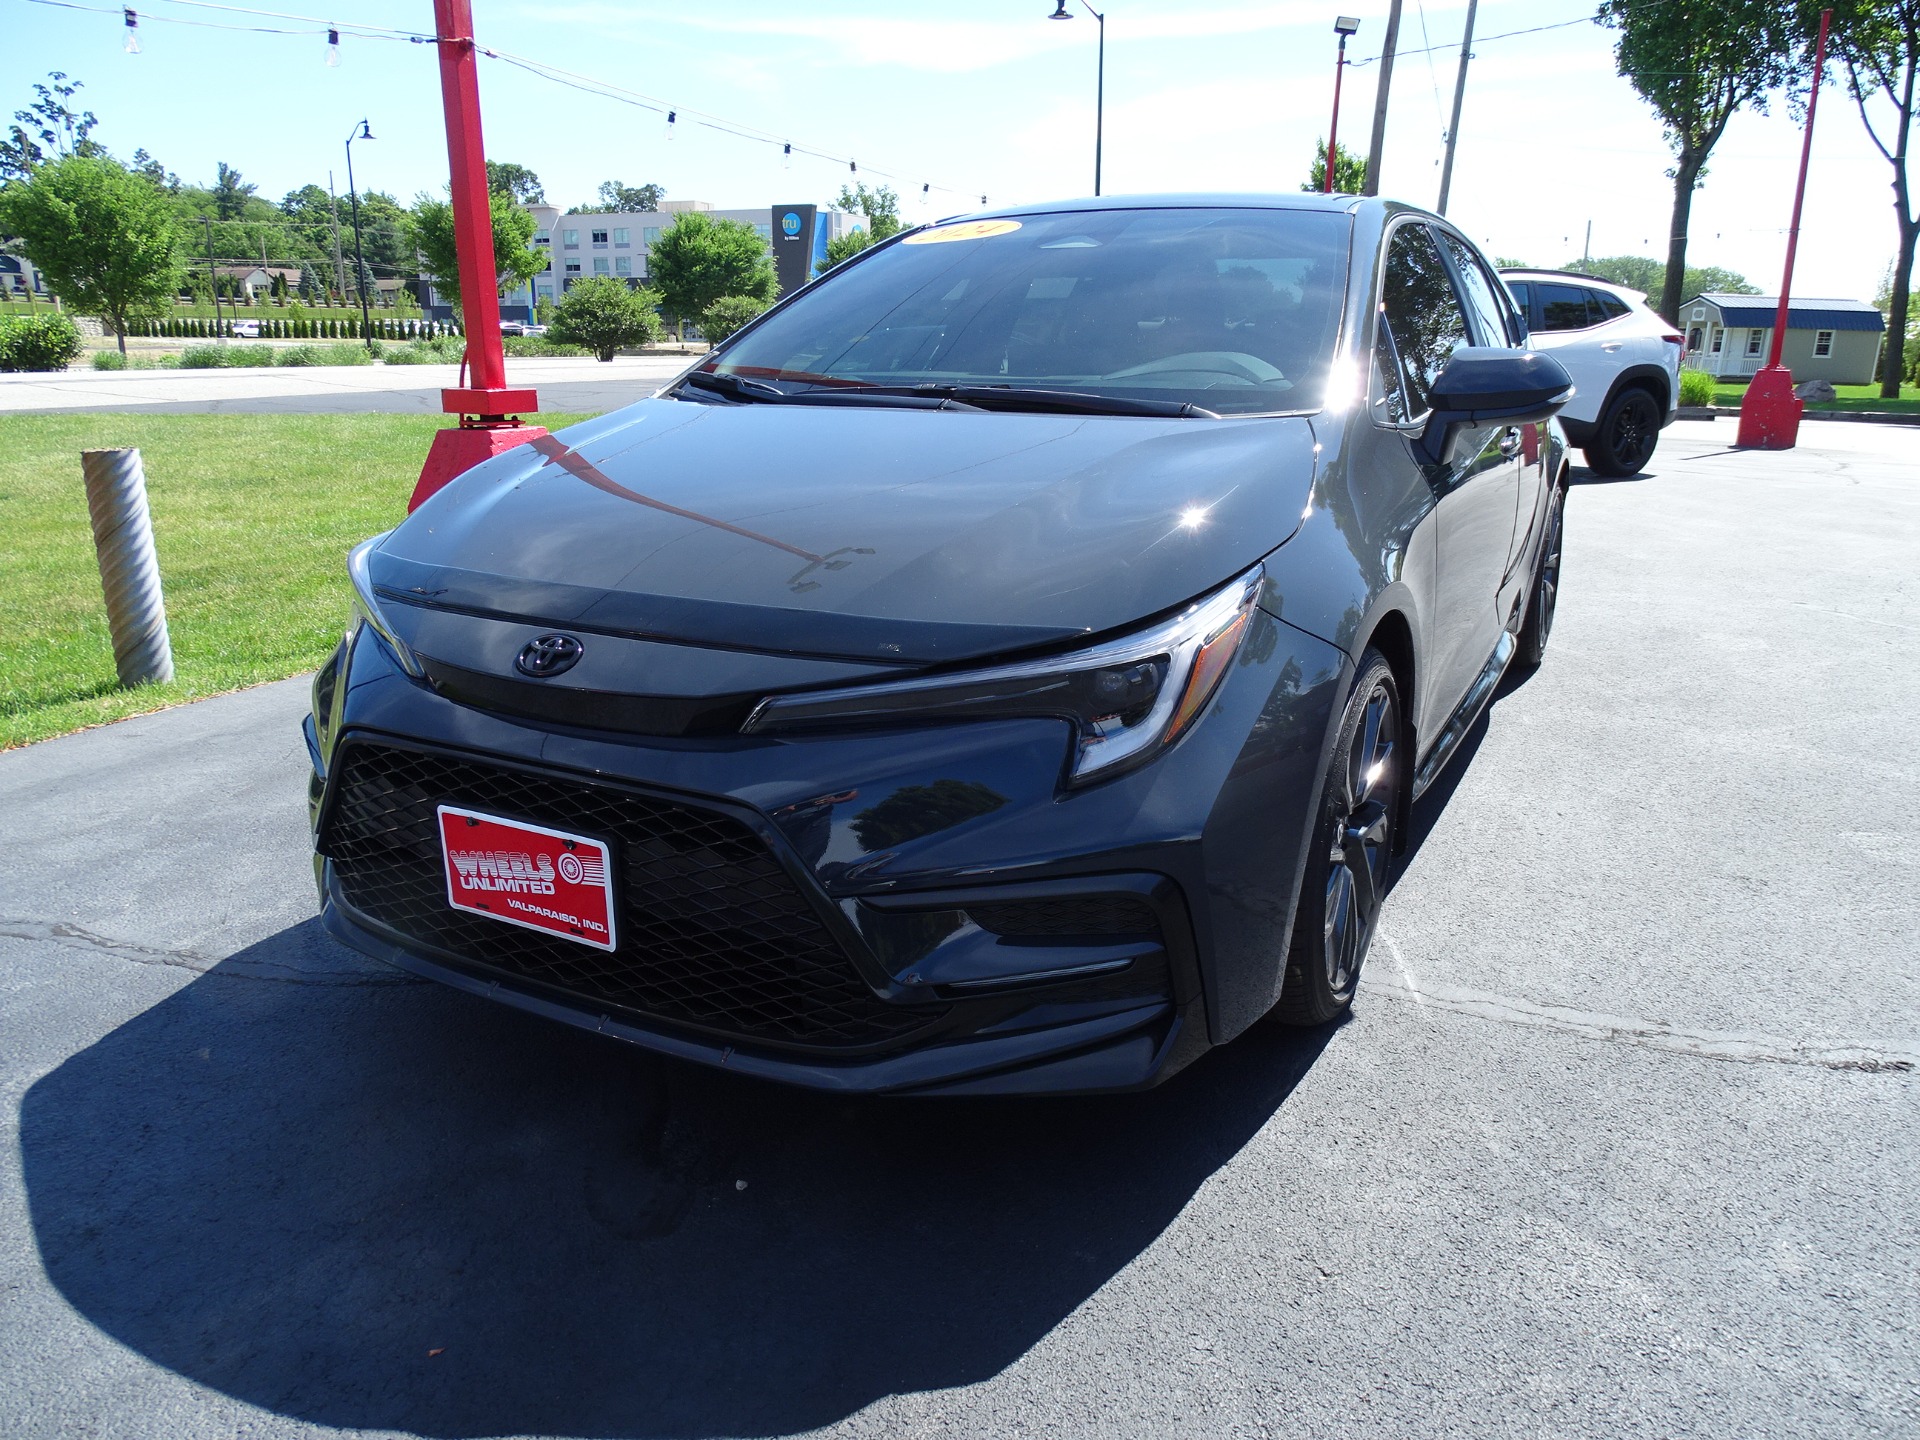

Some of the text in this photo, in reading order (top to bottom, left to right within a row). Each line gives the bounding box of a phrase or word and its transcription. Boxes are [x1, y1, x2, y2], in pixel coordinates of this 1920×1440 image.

[782, 218, 796, 228] tru
[450, 850, 555, 881] WHEELS
[460, 877, 556, 896] UNLIMITED
[507, 898, 608, 934] VALPARAISO, IND.
